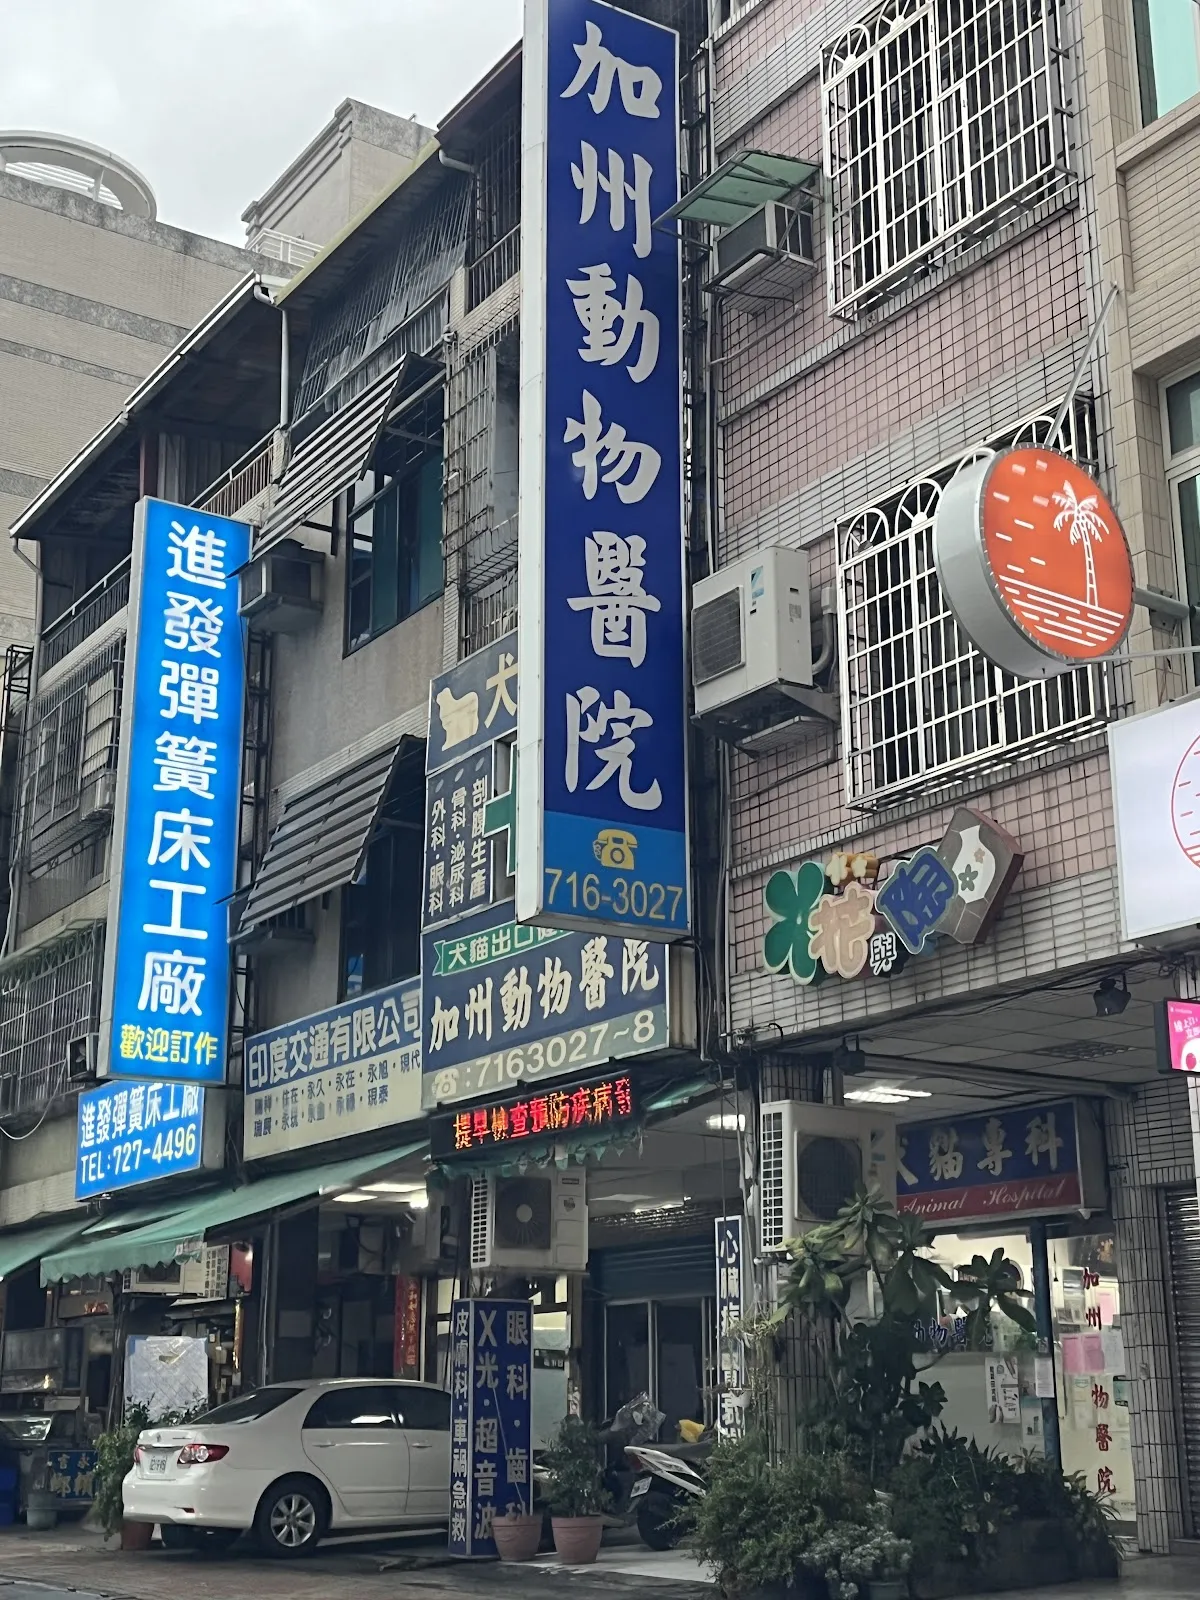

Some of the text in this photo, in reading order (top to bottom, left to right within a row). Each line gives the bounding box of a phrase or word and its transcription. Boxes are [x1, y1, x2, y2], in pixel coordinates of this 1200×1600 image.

[560, 20, 663, 811] 加州動物醫院
[138, 520, 228, 1017] 進發彈簧床工廠
[469, 775, 488, 901] 剖腹生產
[545, 868, 683, 922] 716-3027
[428, 936, 660, 1054] 加州動物醫院
[448, 925, 564, 971] 犬貓出口
[120, 1024, 219, 1066] 歡迎訂作
[248, 988, 422, 1089] 印度交通有限公司
[81, 1083, 199, 1149] 進發彈簧床工廠
[899, 1179, 1066, 1216] Animal Hospital
[1083, 1268, 1117, 1494] 加州物醫院
